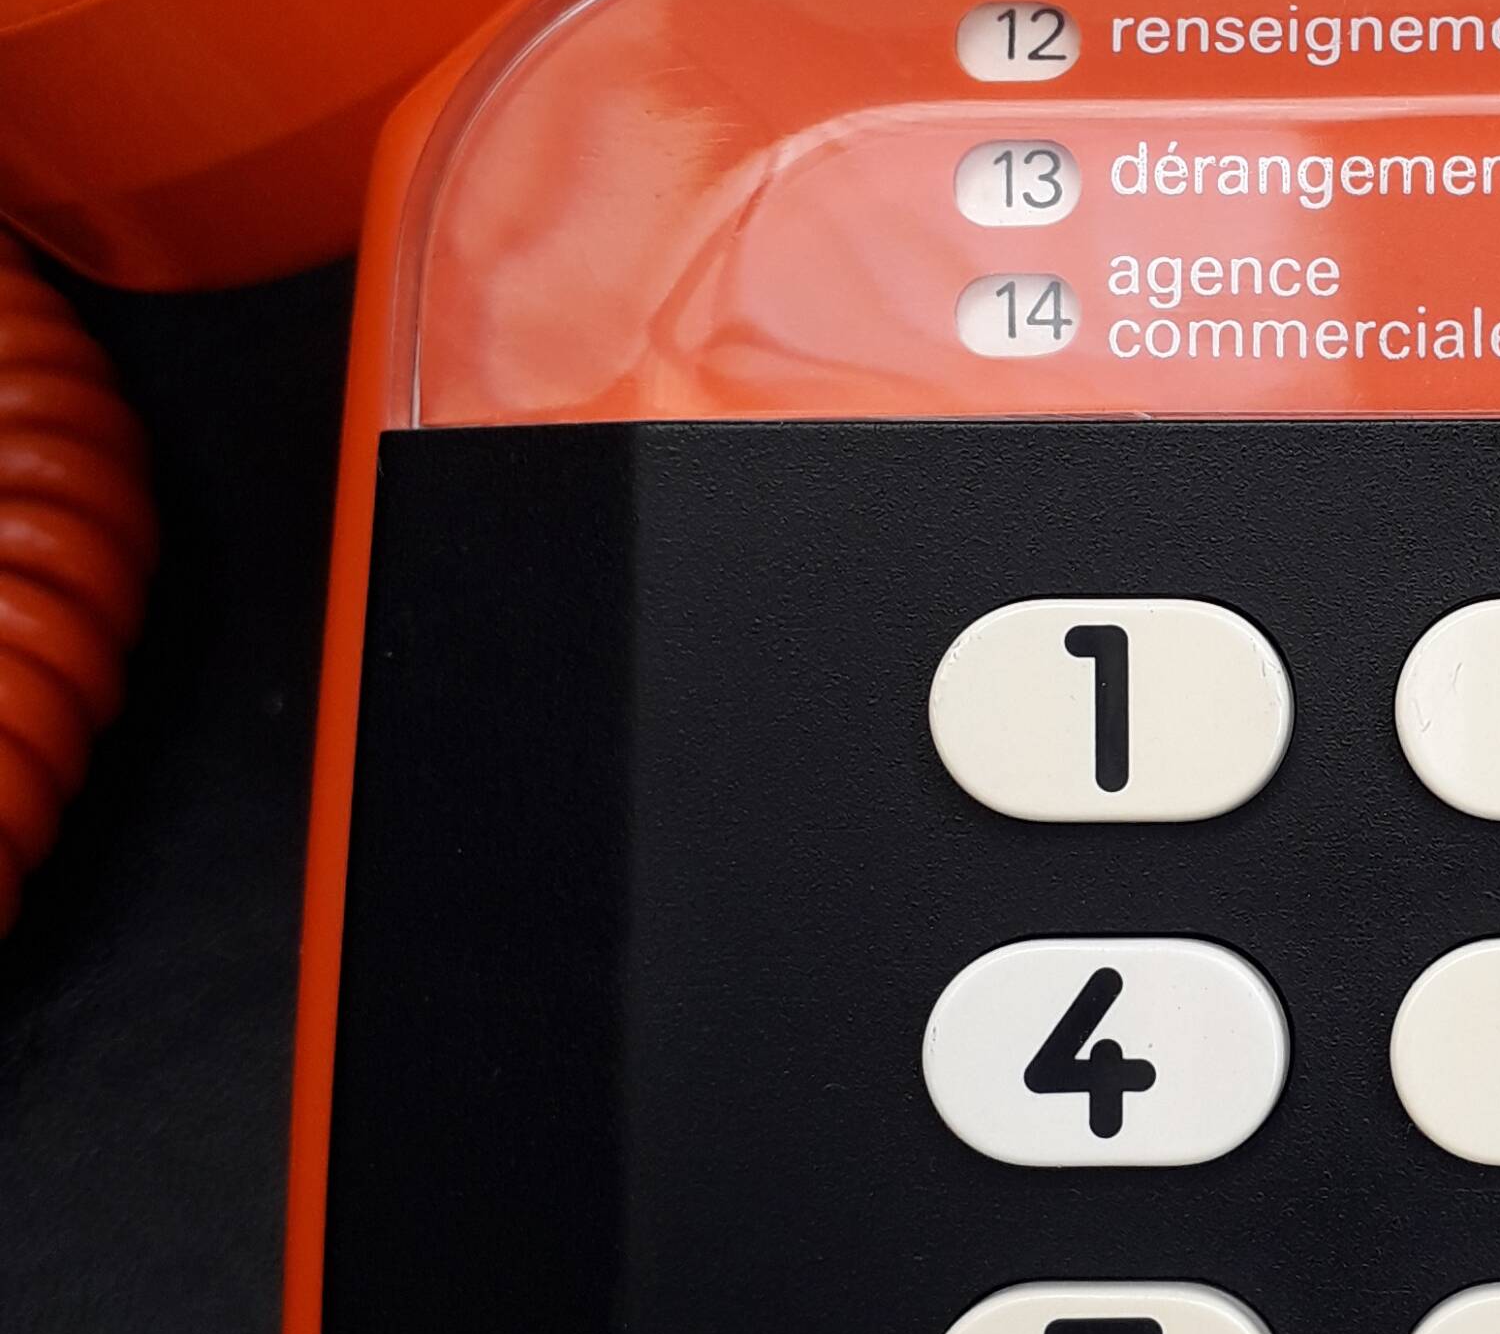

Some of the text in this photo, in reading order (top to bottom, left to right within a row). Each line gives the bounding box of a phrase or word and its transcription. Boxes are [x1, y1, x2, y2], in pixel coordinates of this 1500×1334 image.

[996, 7, 1067, 63] 12
[993, 149, 1063, 209] 13
[1108, 252, 1340, 309] agence
[996, 282, 1073, 341] 14
[1065, 625, 1129, 792] 1
[1024, 968, 1156, 1138] 4
